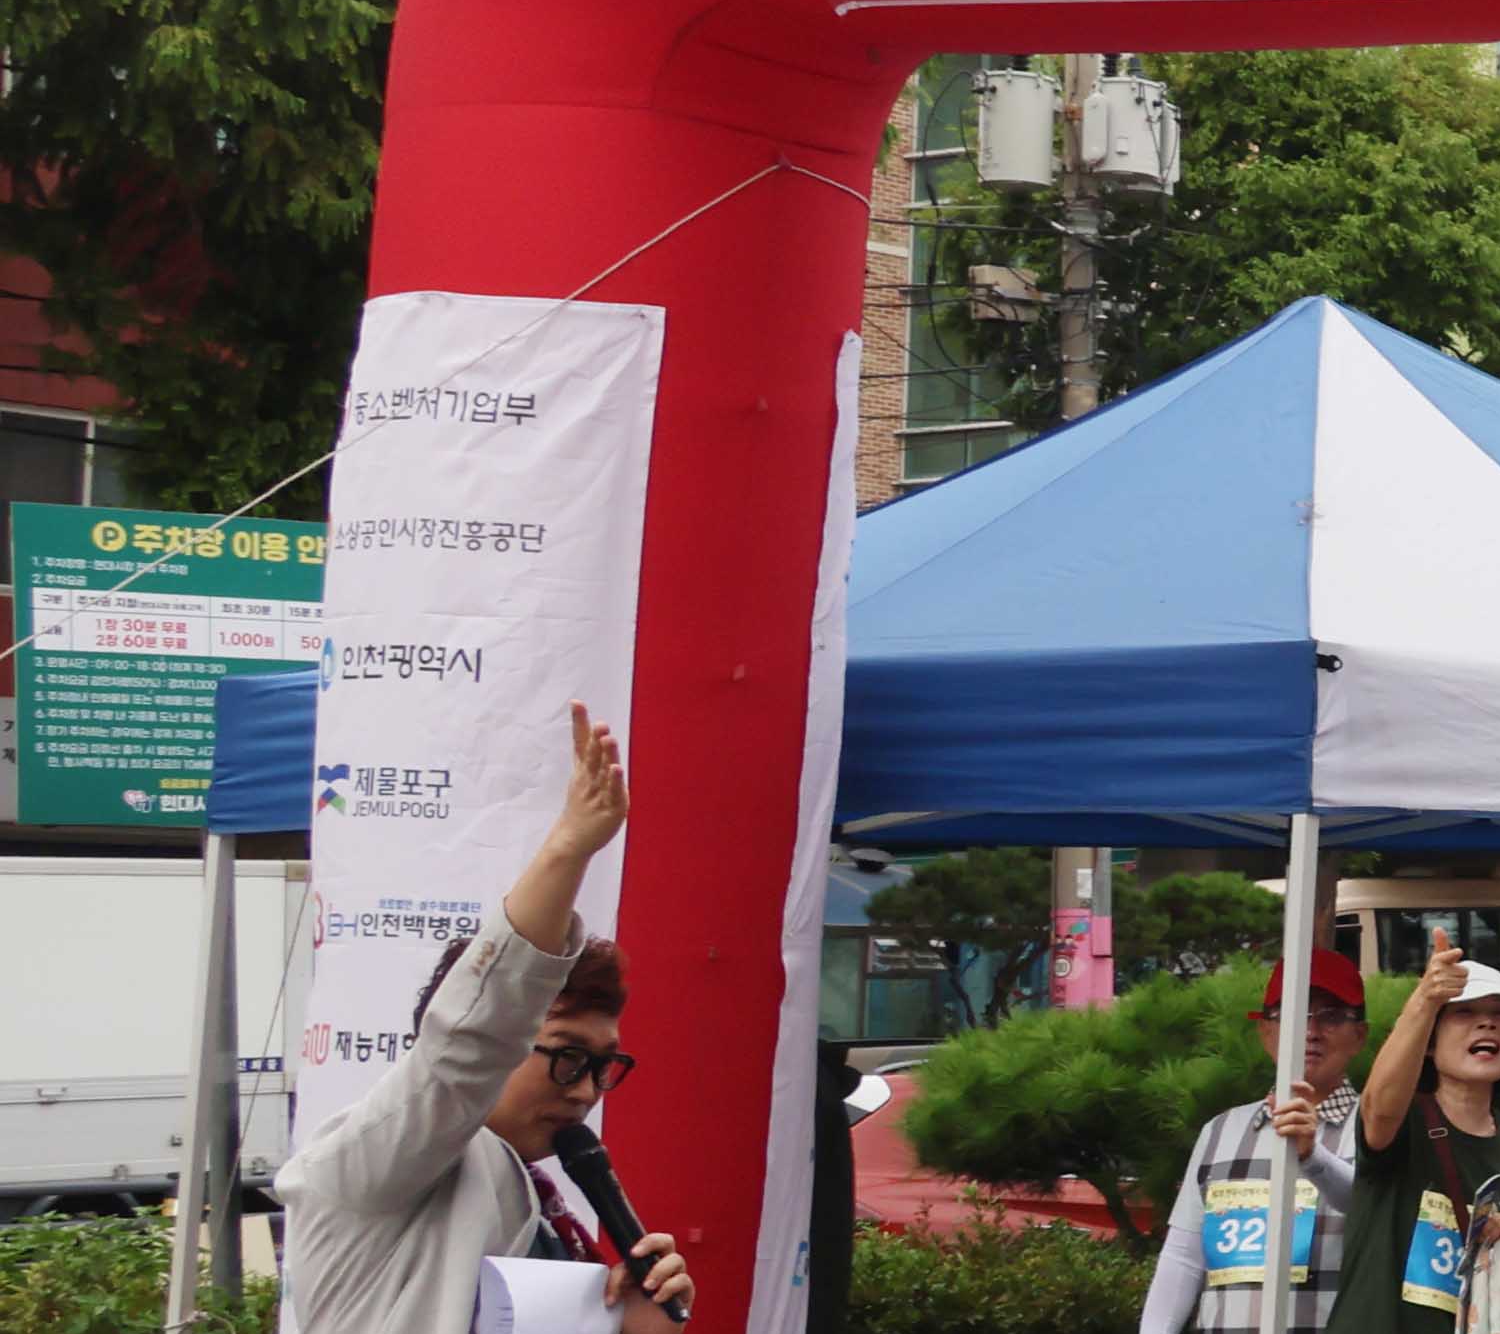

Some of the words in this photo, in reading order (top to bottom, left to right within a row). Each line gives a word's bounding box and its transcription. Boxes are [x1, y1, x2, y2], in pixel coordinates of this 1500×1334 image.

[355, 385, 537, 426] 중소벤처기업부
[131, 523, 227, 558] 주차장
[231, 530, 290, 562] 이용
[296, 533, 327, 565] 안
[334, 517, 548, 553] 소상공인시장진흥공단
[246, 604, 272, 616] 30분
[95, 618, 118, 632] 1장
[122, 618, 157, 633] 30분
[161, 621, 188, 635] 무료
[95, 634, 118, 648] 2장
[122, 634, 157, 649] 60분
[161, 636, 188, 650] 무료
[300, 635, 322, 651] 50
[342, 644, 483, 683] 인천광역시
[354, 767, 453, 799] 제물포구
[351, 800, 451, 819] JEMULPOGU
[360, 913, 481, 941] 인천백병원
[1216, 1217, 1267, 1254] 32
